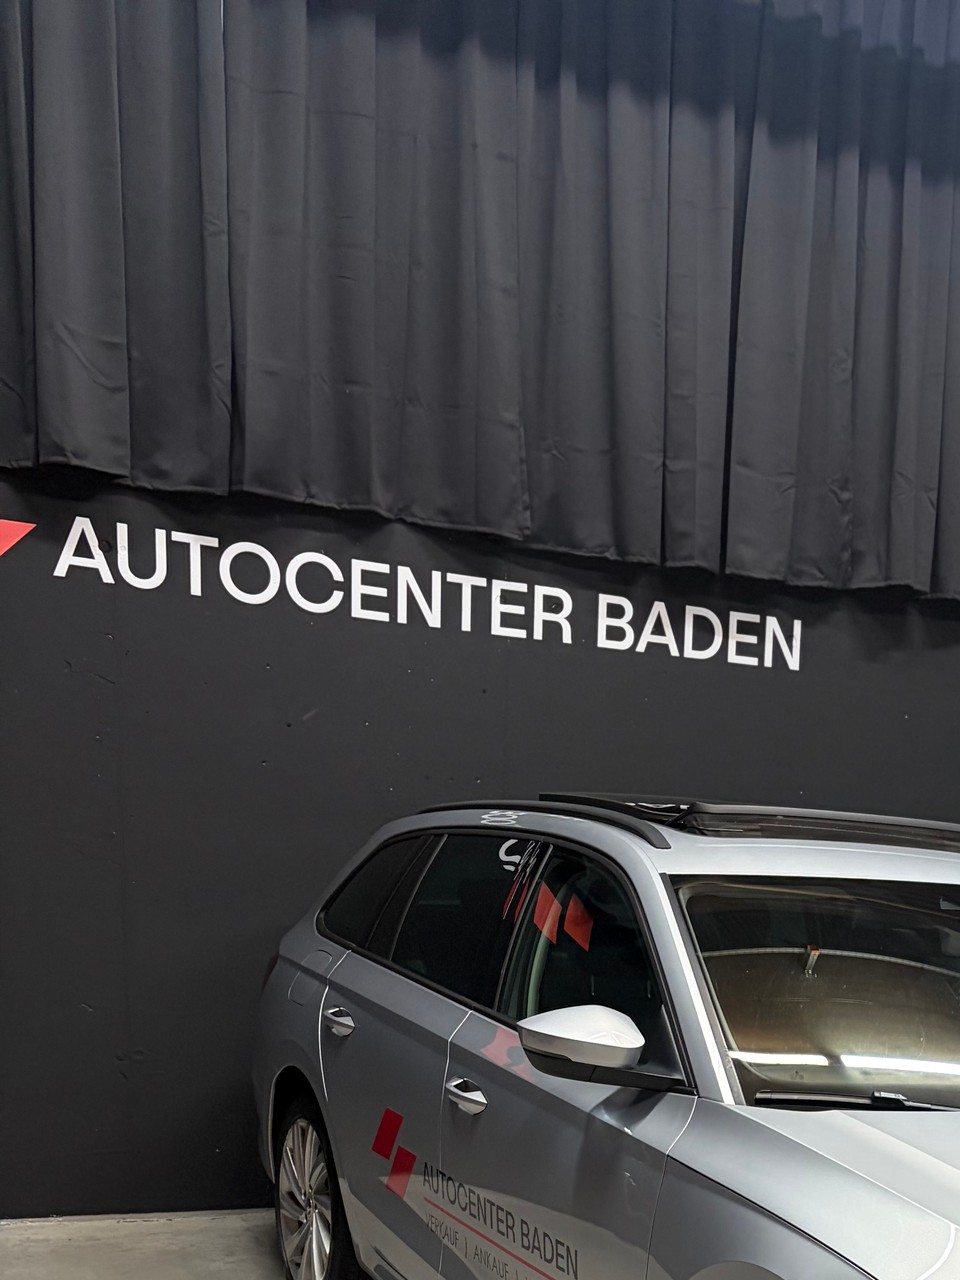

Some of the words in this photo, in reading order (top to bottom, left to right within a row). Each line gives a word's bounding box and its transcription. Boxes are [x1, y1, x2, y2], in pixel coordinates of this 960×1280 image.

[53, 516, 572, 645] AUTOCENTER
[596, 593, 804, 671] BADEN
[422, 1161, 516, 1243] AUTOCENTER
[424, 1212, 460, 1249] VERKAUF
[473, 1244, 510, 1280] ANKAUF
